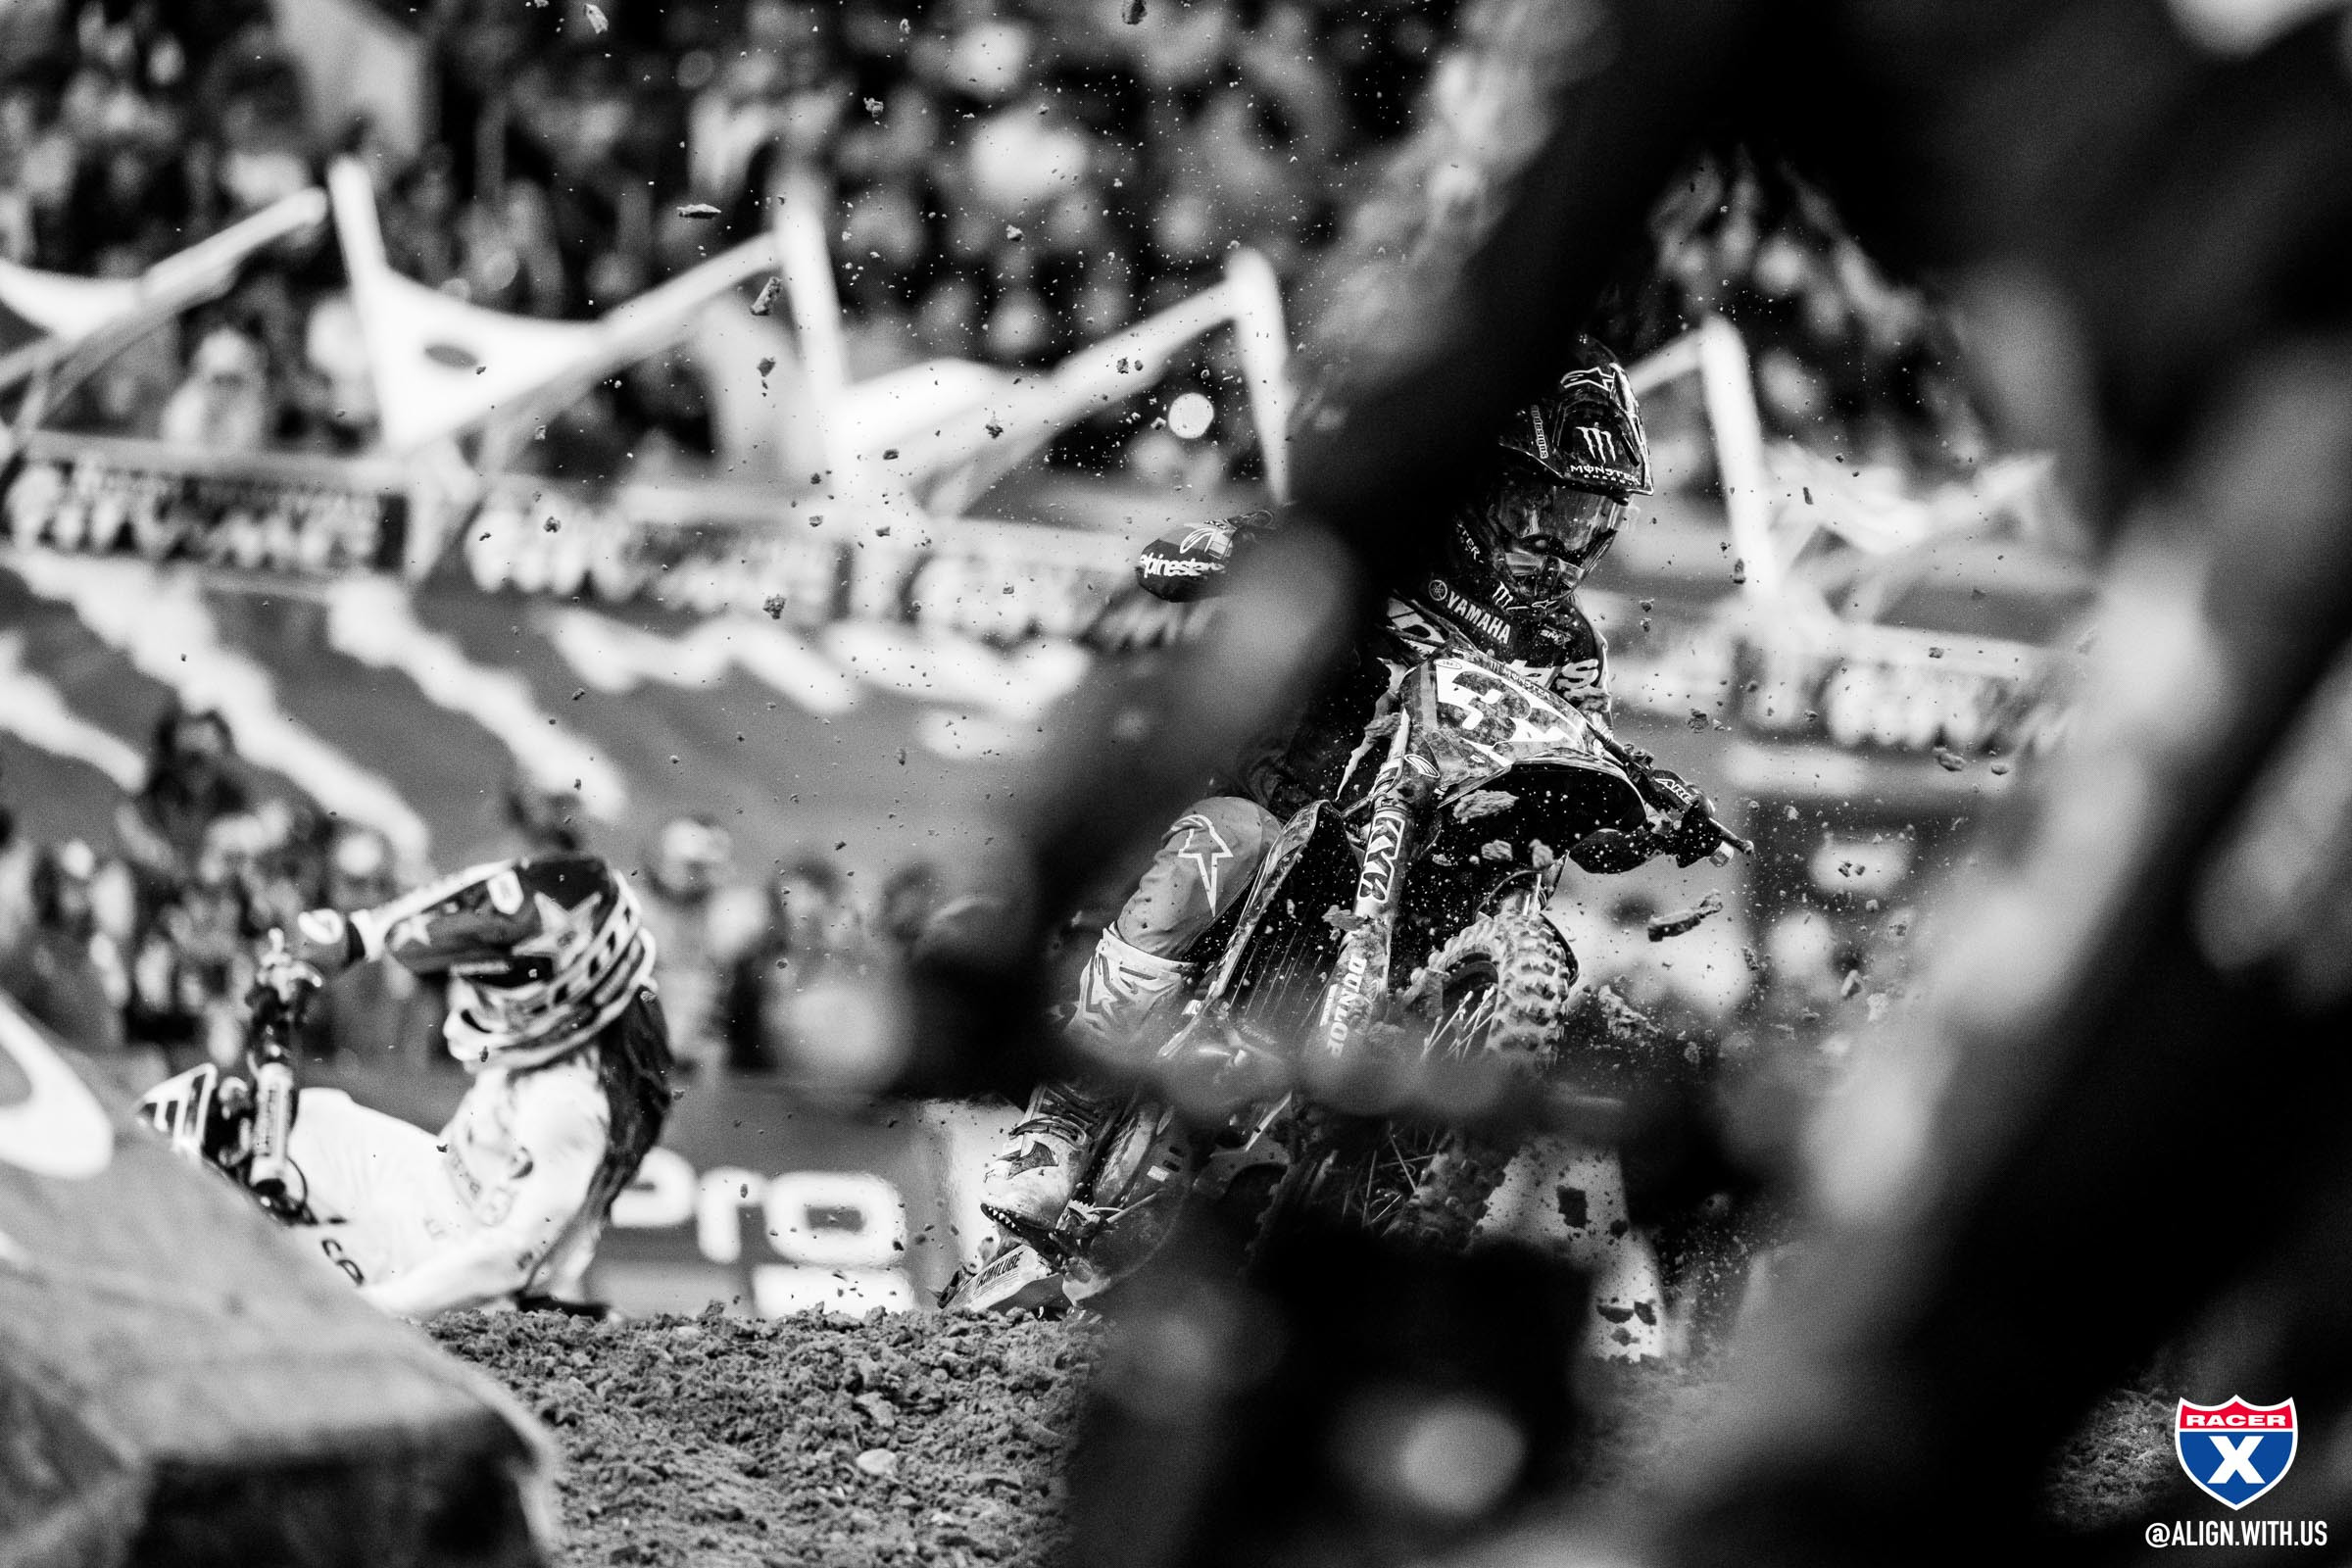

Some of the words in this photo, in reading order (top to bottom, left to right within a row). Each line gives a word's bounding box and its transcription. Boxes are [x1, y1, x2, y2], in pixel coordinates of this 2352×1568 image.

[1446, 591, 1512, 645] YAMAHA
[1327, 954, 1365, 1058] DUNLOP
[975, 1250, 1023, 1290] AMALUBE
